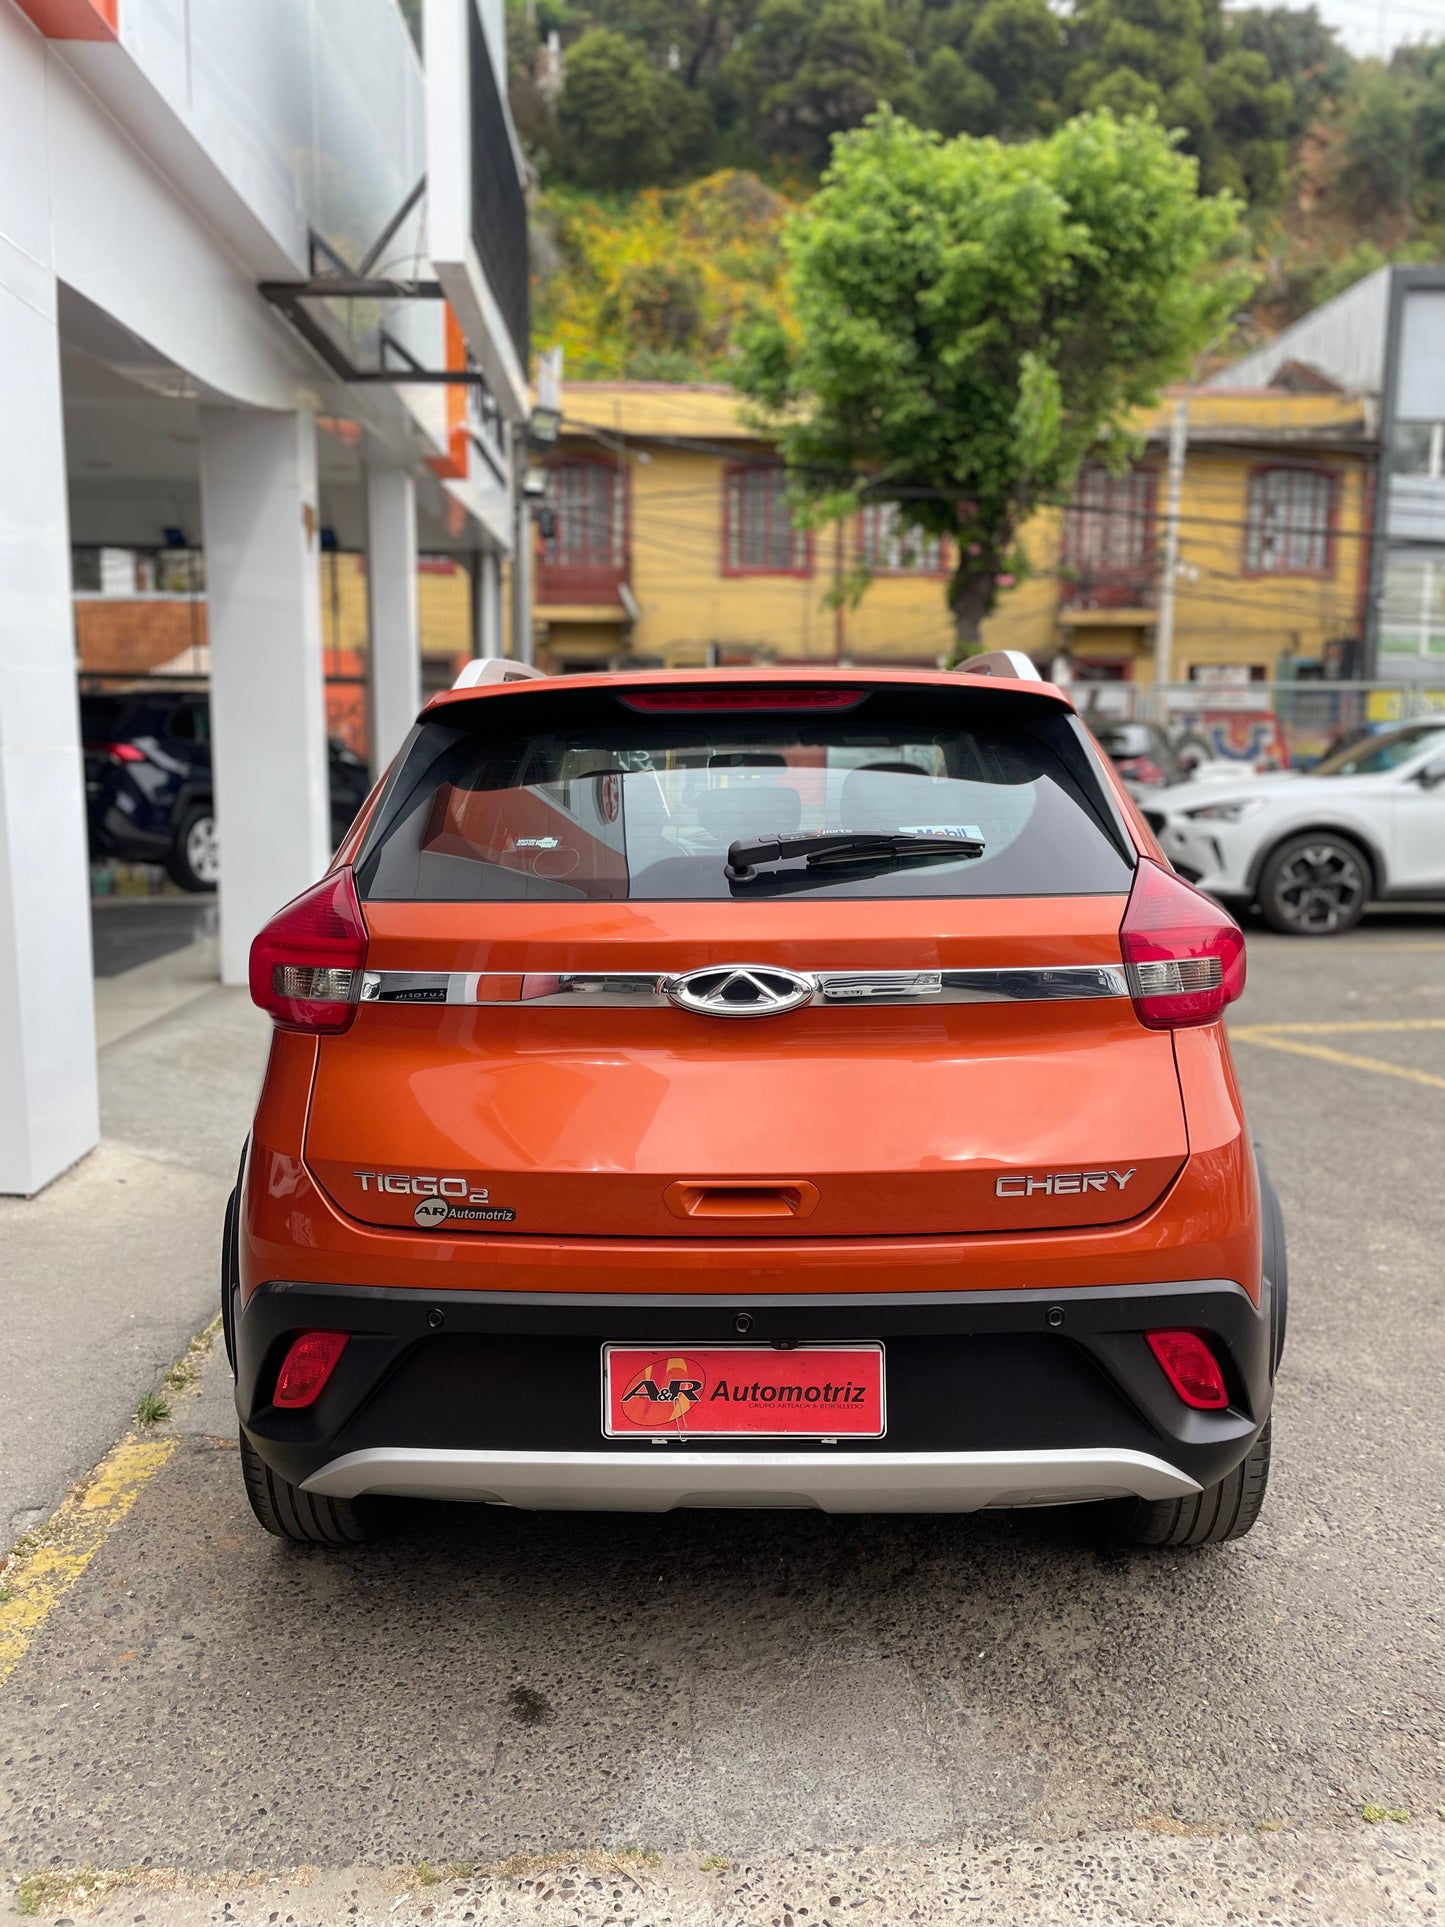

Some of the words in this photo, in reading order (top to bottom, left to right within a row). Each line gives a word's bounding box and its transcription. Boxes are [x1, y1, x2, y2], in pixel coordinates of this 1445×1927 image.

[996, 1168, 1137, 1198] CHERY
[416, 1206, 446, 1217] AR
[447, 1208, 513, 1221] Automotriz
[621, 1379, 702, 1403] A&R
[710, 1381, 867, 1403] Automotriz
